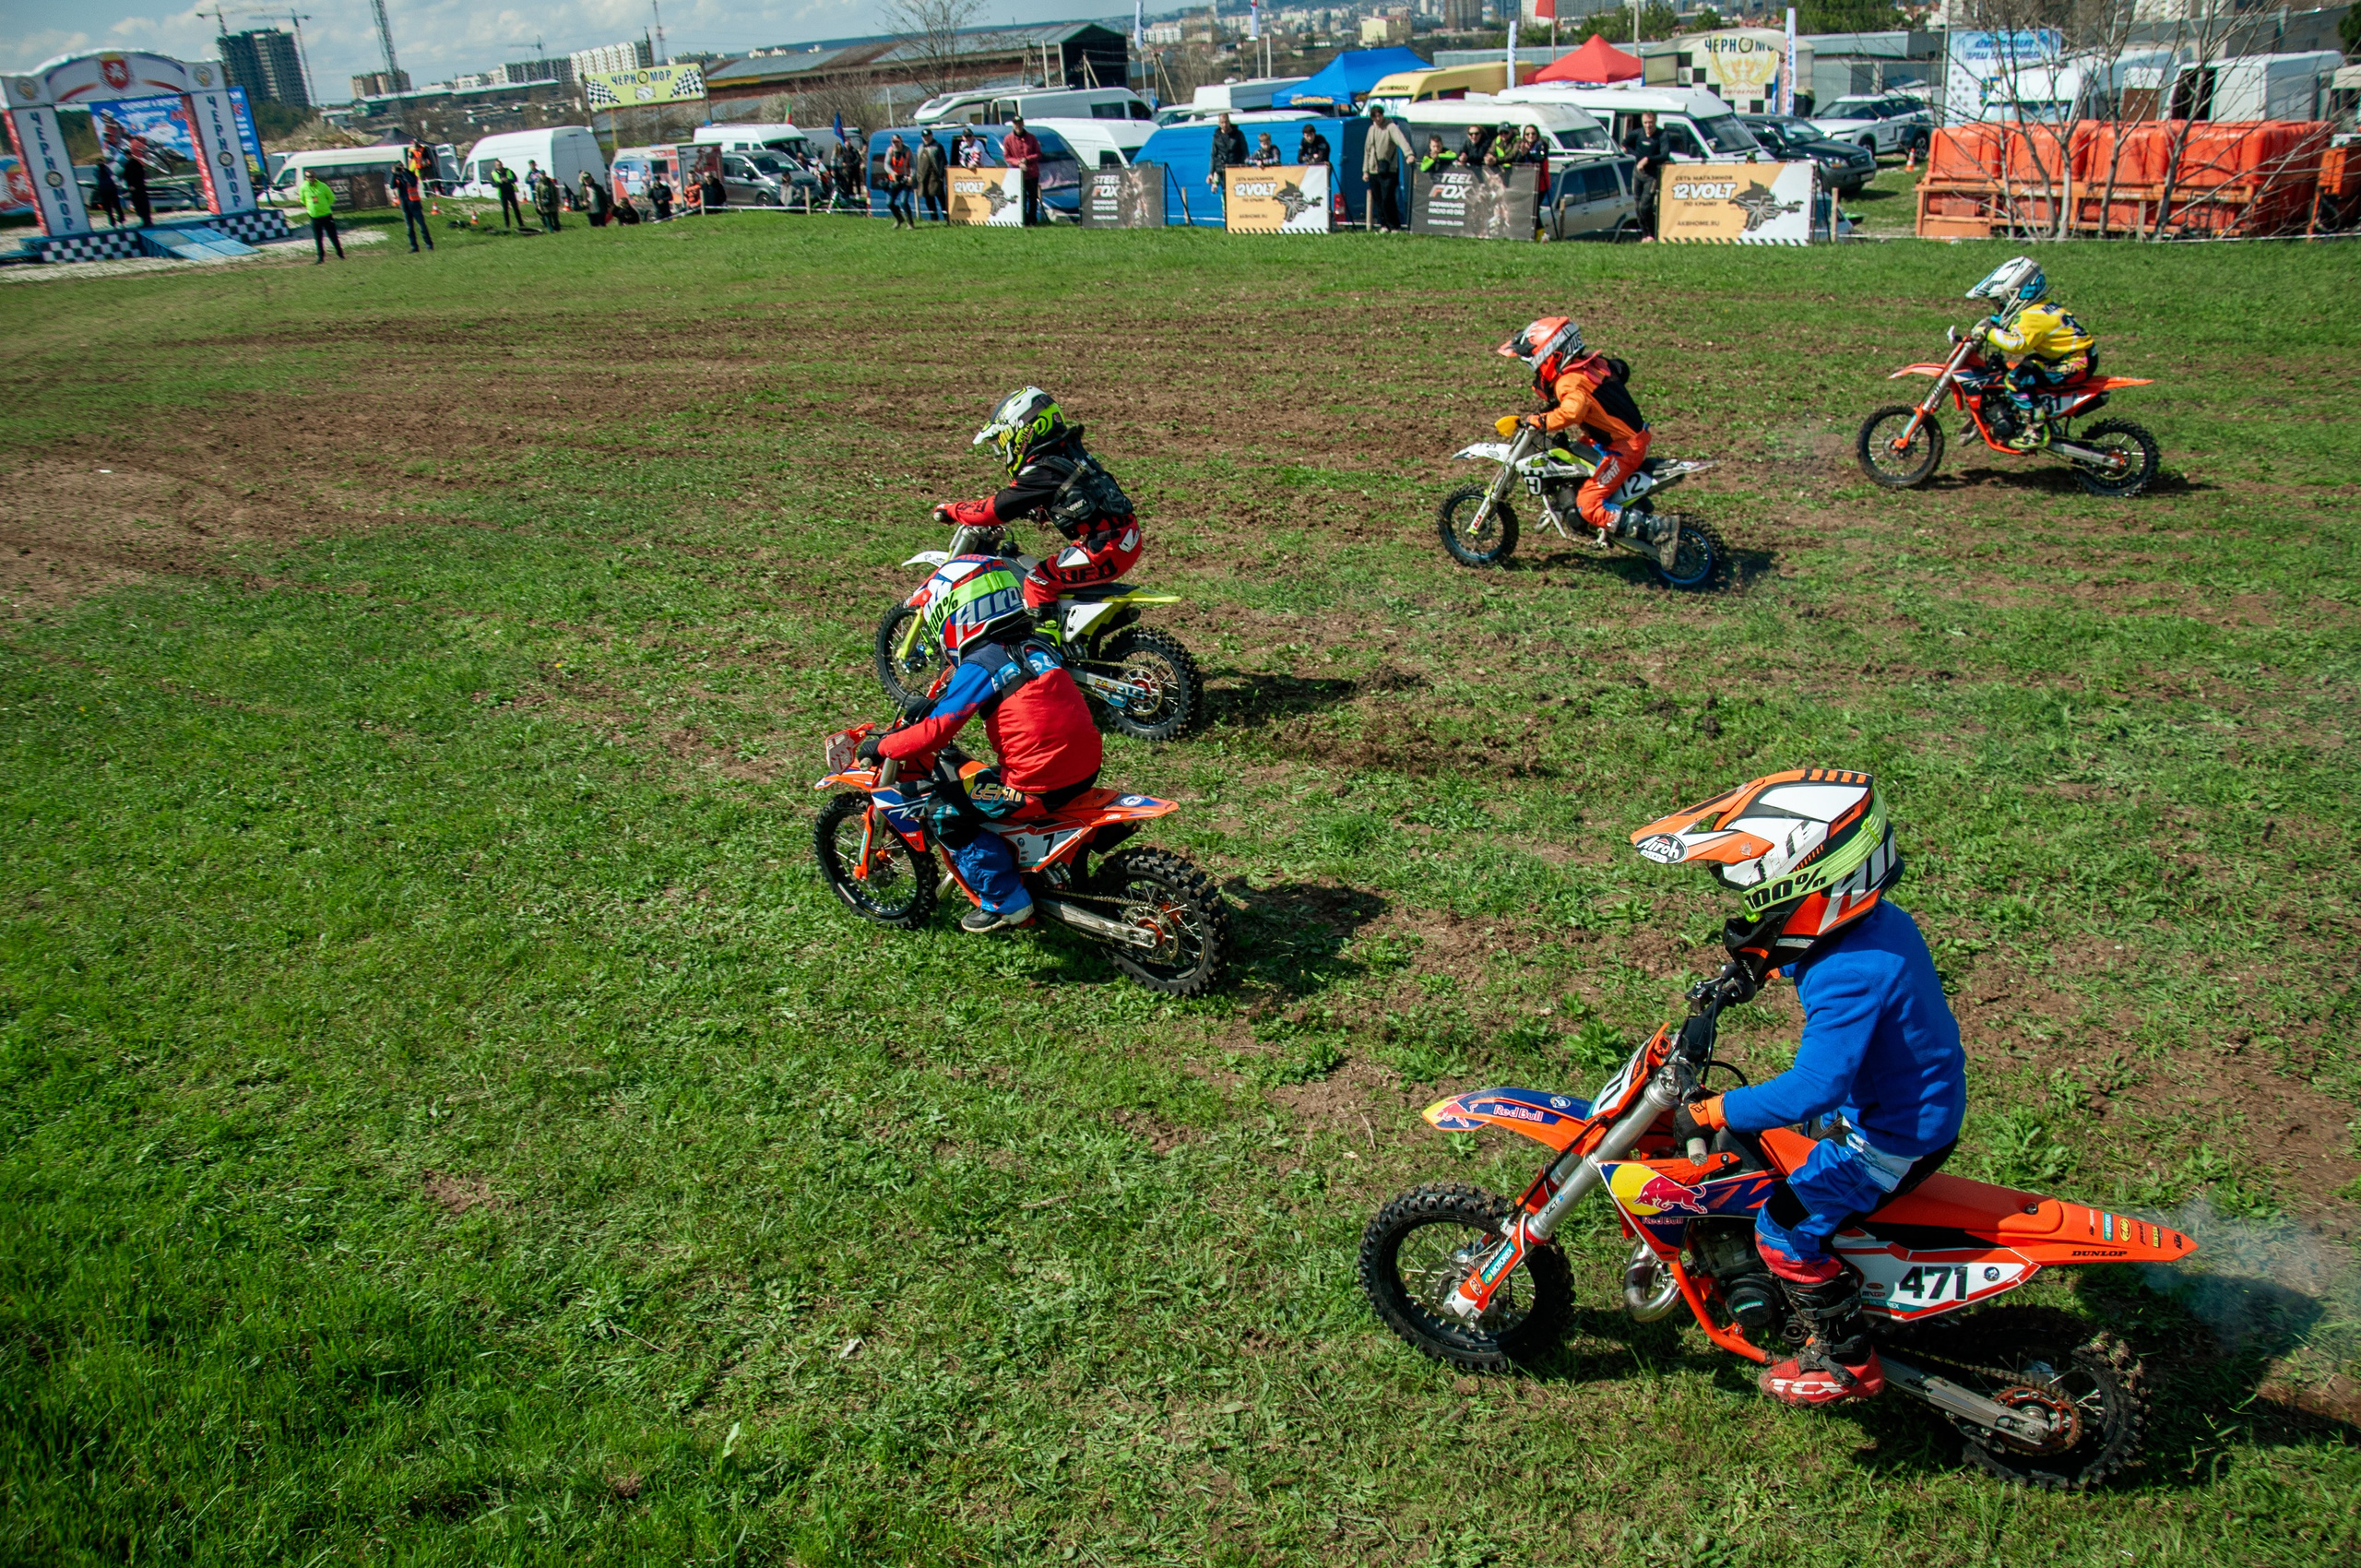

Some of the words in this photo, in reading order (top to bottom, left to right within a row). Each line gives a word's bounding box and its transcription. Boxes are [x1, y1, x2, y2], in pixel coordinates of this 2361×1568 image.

[611, 70, 671, 86] ЧЕРНОМОР
[954, 181, 985, 193] 12VOLT
[1092, 175, 1121, 184] STEEL
[1092, 184, 1120, 197] FOX
[1234, 183, 1276, 196] 12VOLT
[1429, 184, 1472, 199] FOX
[1672, 183, 1738, 199] 12VOLT
[1061, 558, 1118, 584] UFO
[1636, 836, 1679, 860] Airoh
[1744, 866, 1826, 909] 100%
[1493, 1104, 1519, 1118] Red
[1518, 1108, 1544, 1122] Bull
[1643, 1216, 1664, 1225] Red
[1664, 1217, 1684, 1225] Bull
[2174, 1233, 2183, 1250] KTM
[1489, 1246, 1514, 1277] MOTOREX
[1899, 1266, 1968, 1300] 471
[1869, 1300, 1900, 1310] MOTOREX
[1769, 1378, 1845, 1395] TCX
